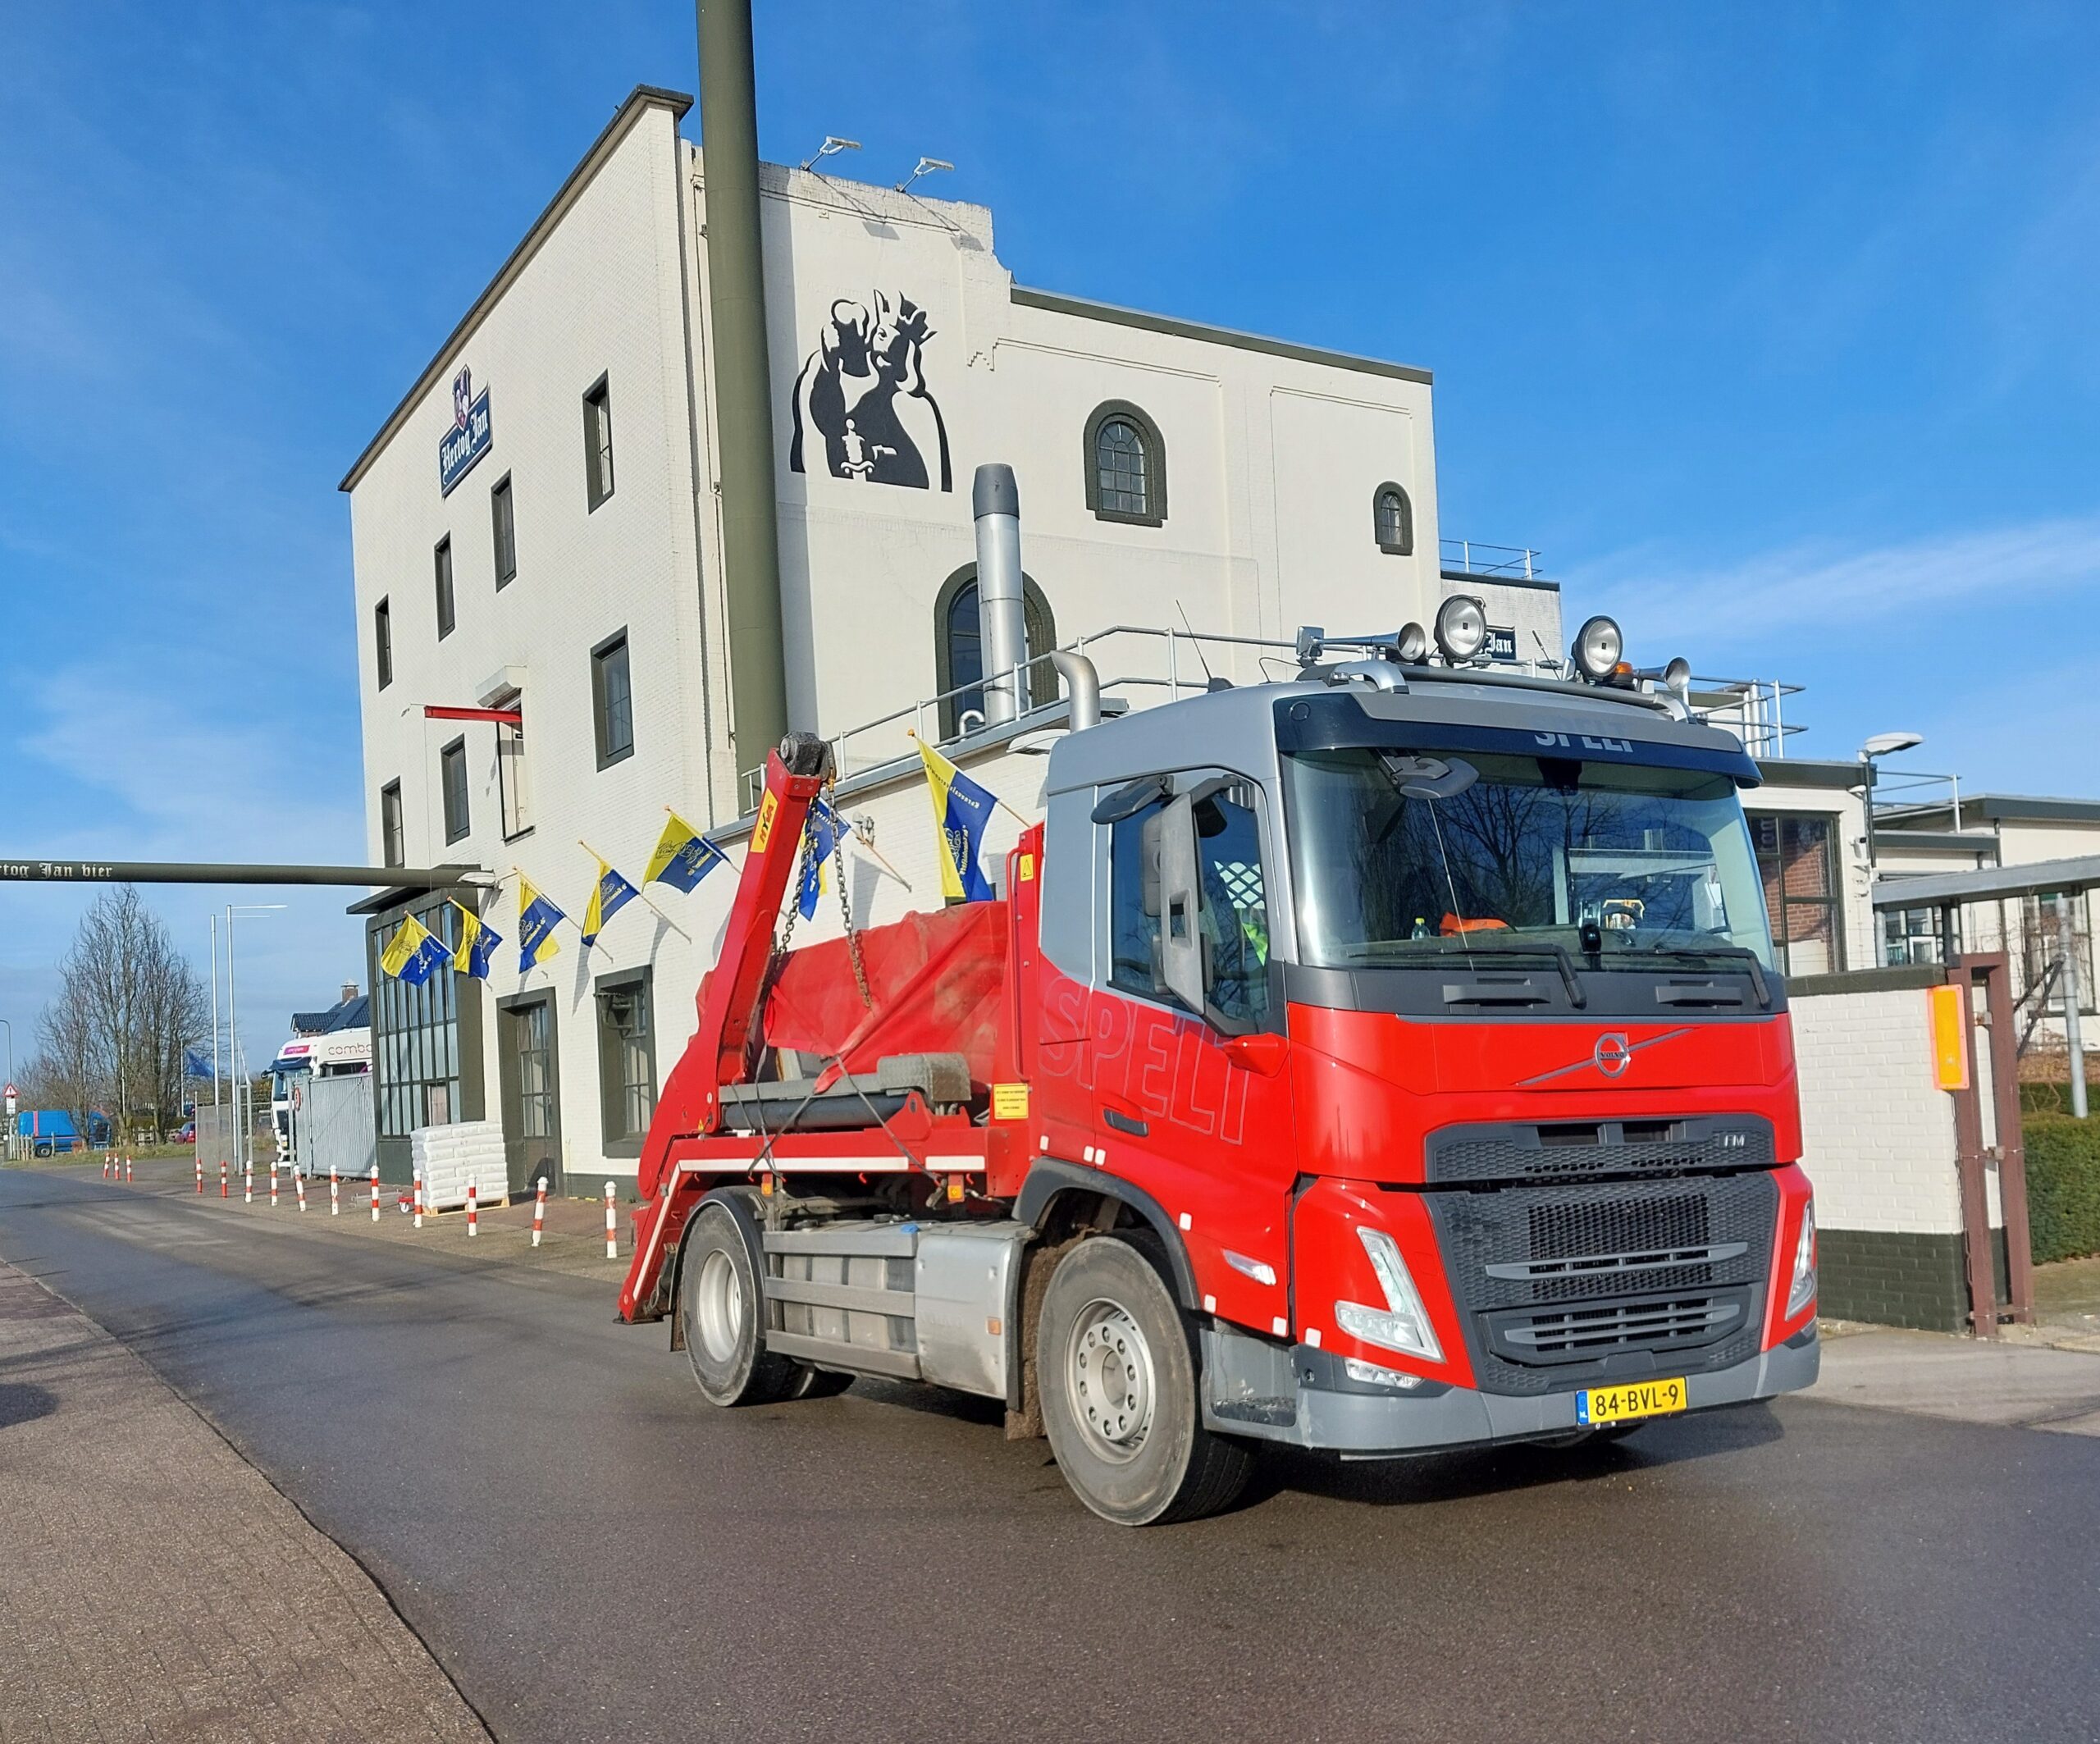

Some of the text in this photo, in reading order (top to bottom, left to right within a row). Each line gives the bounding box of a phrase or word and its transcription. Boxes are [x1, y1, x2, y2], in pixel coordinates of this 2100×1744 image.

[441, 409, 488, 485] Hertog Jan
[759, 803, 774, 844] HYVA
[39, 862, 73, 879] Jan
[81, 864, 113, 877] bier
[1724, 1135, 1746, 1147] FM
[1596, 1384, 1678, 1417] 84-BVL-9
[1579, 1410, 1588, 1418] NL
